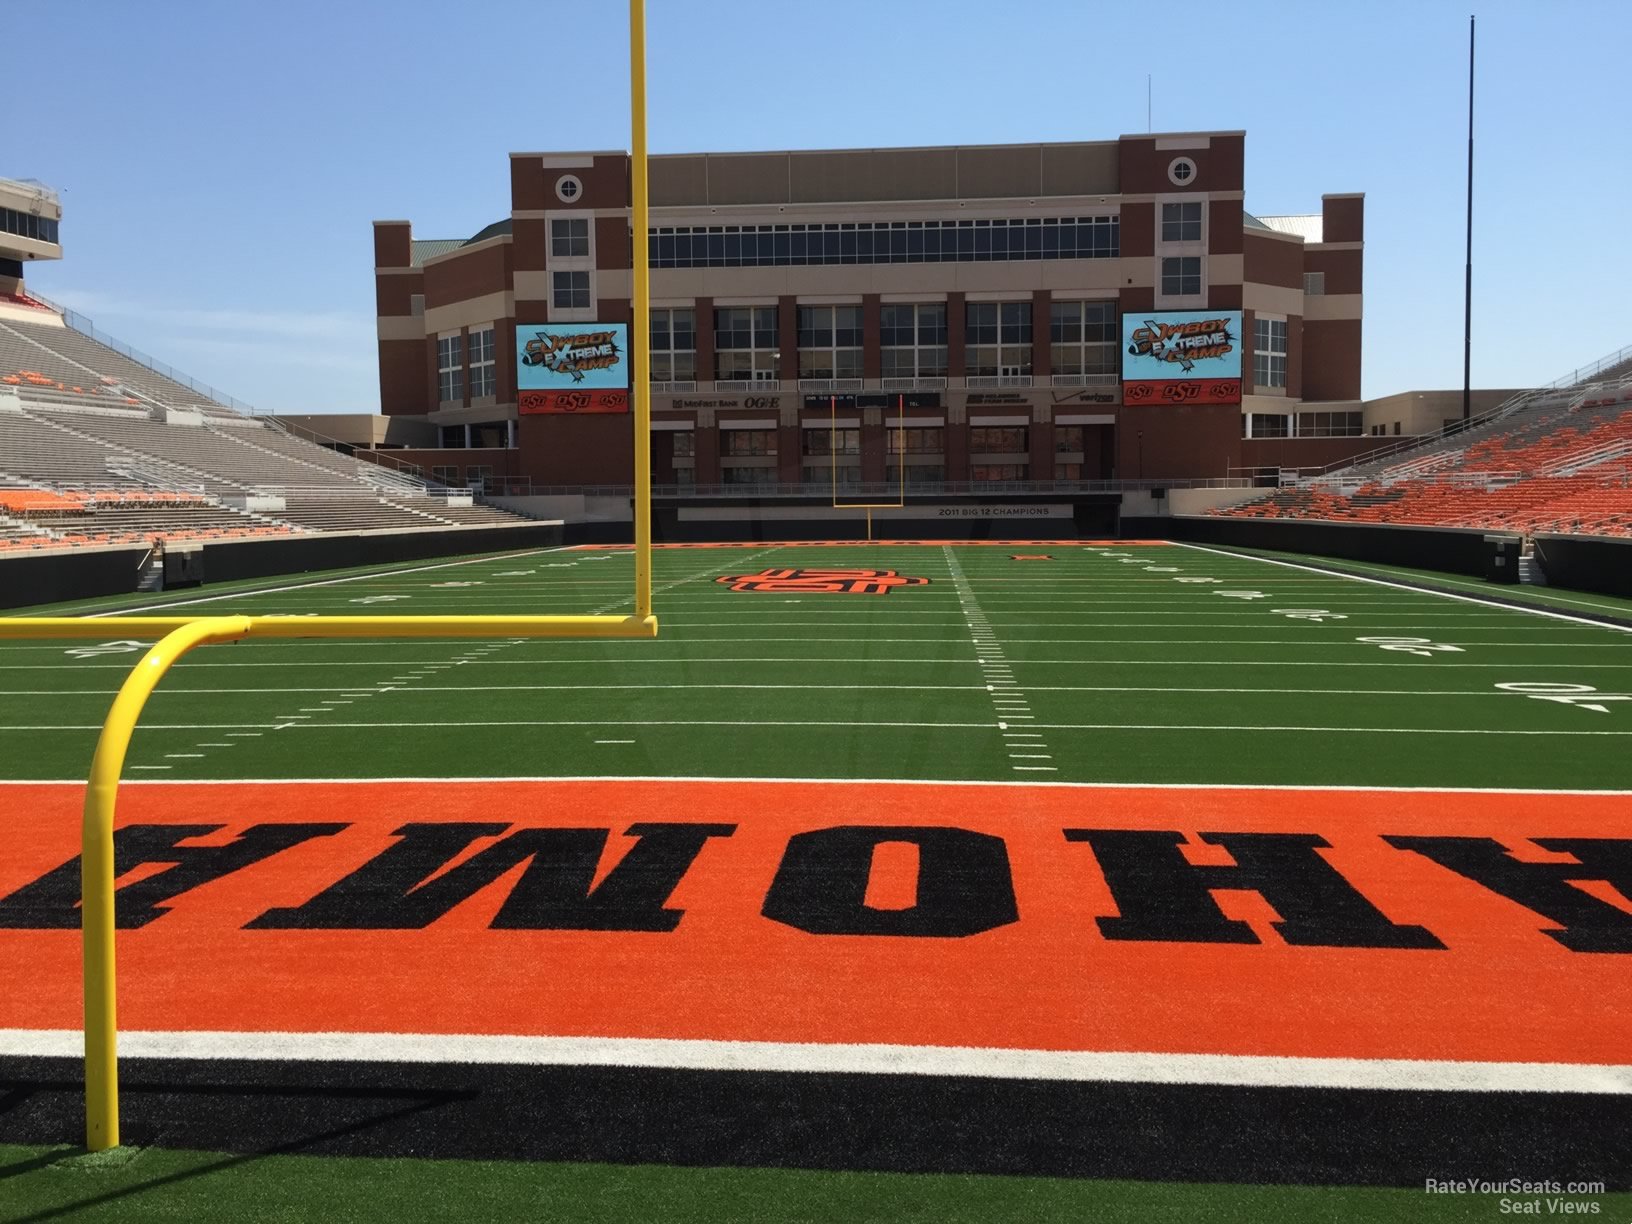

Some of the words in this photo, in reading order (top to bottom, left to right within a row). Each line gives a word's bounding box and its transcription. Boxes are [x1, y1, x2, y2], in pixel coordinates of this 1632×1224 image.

[1132, 318, 1231, 342] COWBOY
[526, 331, 617, 353] COWBOY
[1152, 331, 1226, 359] EXTREME
[544, 343, 614, 369] EXTREME
[1168, 344, 1233, 363] CAMP
[558, 356, 620, 374] CAMP
[521, 394, 546, 408] OSU
[555, 391, 592, 411] OSU
[600, 393, 626, 408] OSU
[1080, 393, 1114, 402] verizon
[1127, 384, 1154, 399] OSU
[1162, 381, 1202, 402] OSU
[1209, 383, 1238, 398] OSU
[993, 507, 1049, 515] CHAMPIONS
